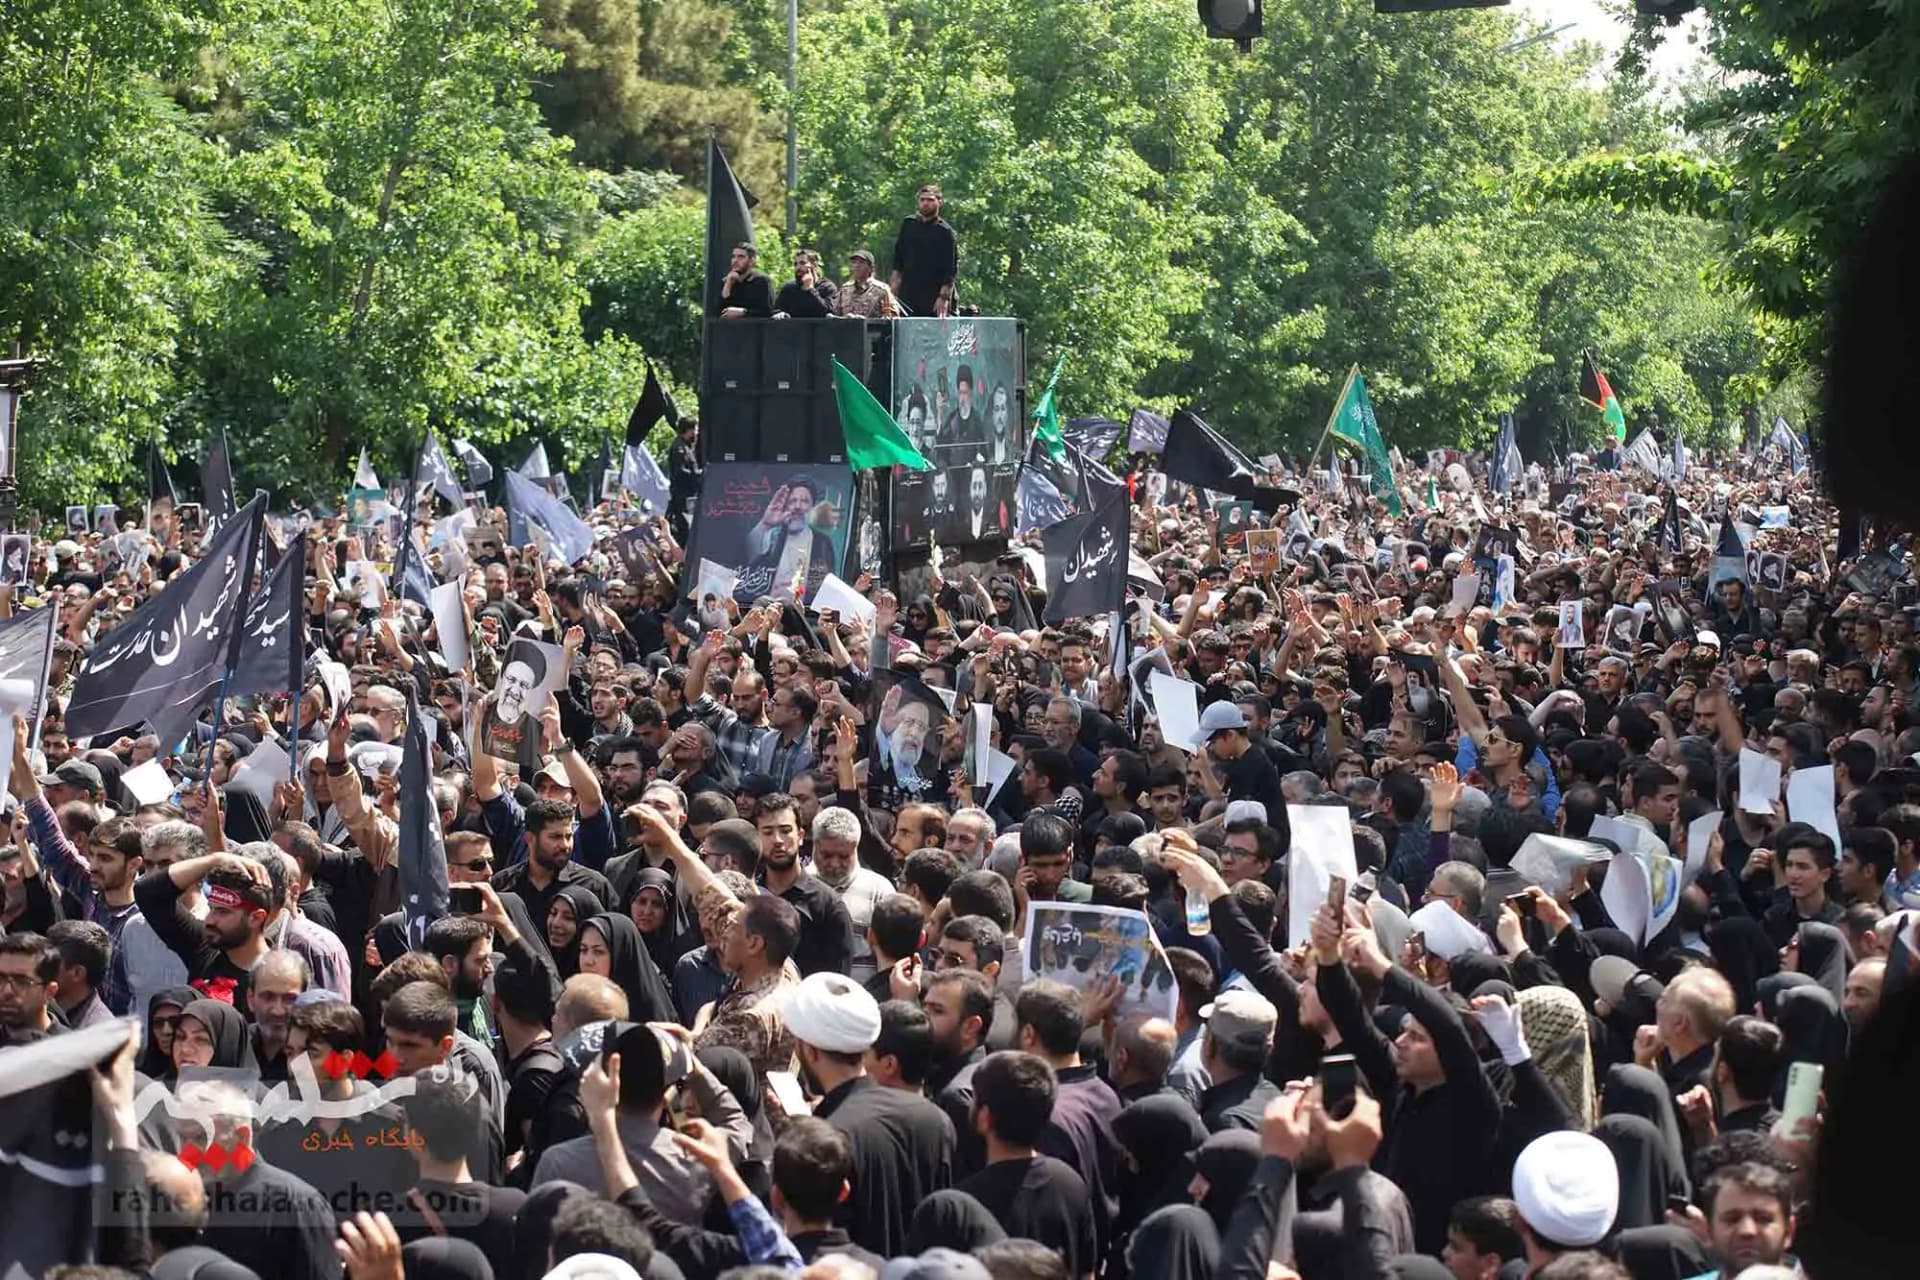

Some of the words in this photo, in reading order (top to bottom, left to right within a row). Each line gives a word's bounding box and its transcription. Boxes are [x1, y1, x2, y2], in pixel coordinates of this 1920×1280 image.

[1063, 525, 1114, 584] شهیدان
[151, 555, 237, 667] شهیدان
[250, 608, 291, 648] سید
[89, 618, 154, 675] خدمت
